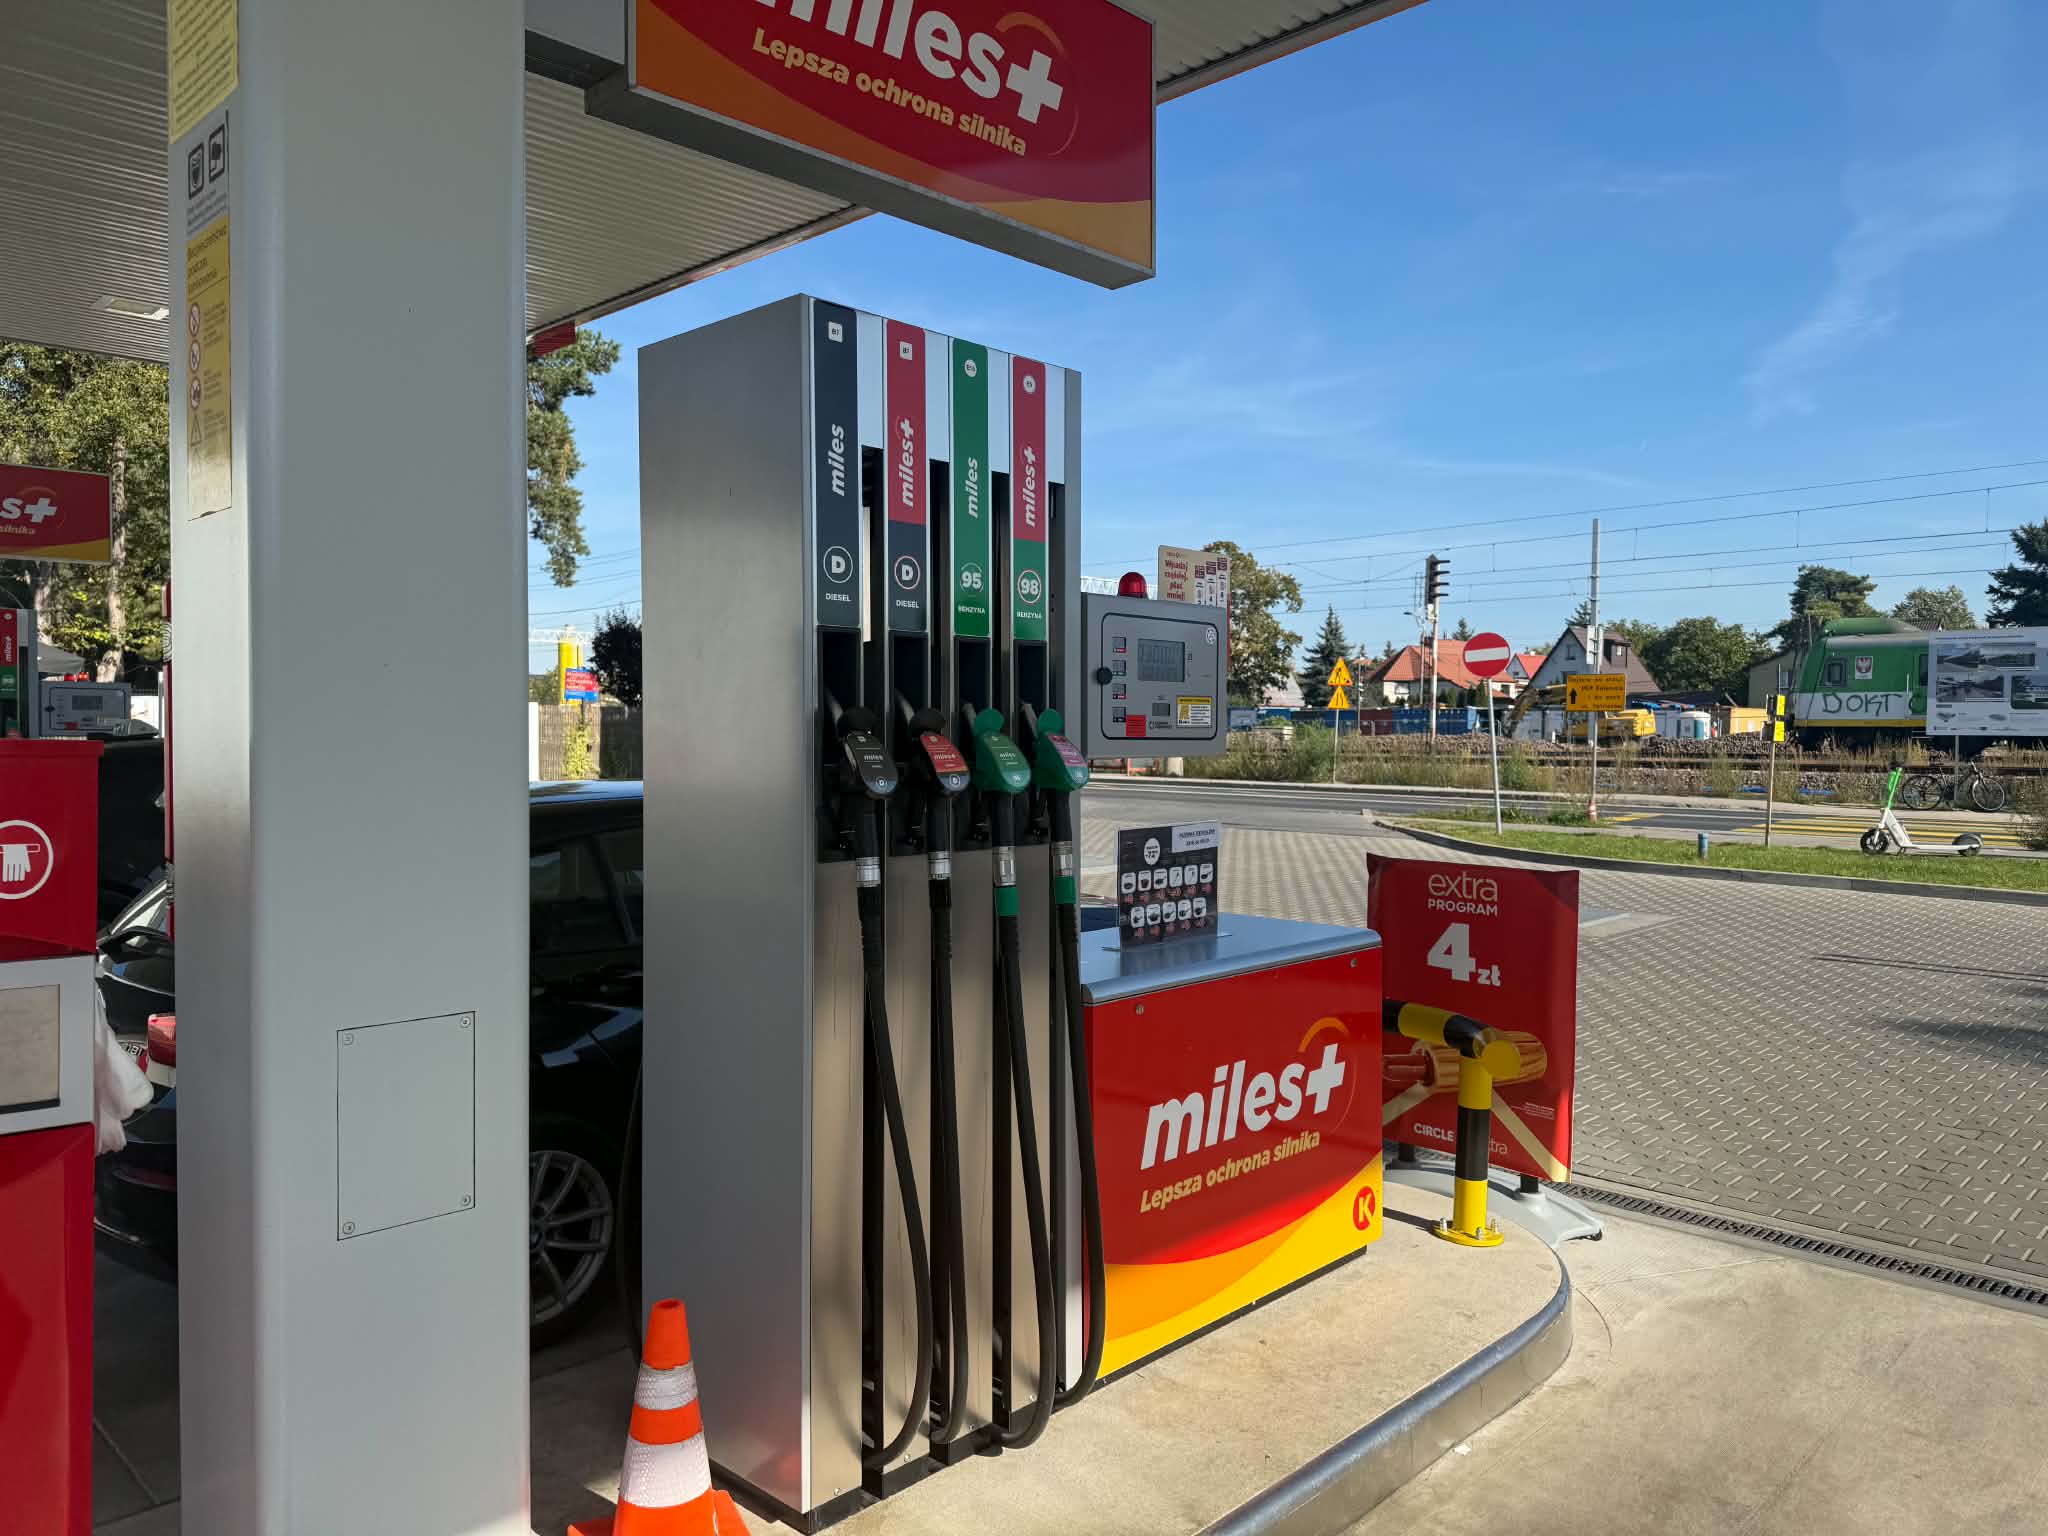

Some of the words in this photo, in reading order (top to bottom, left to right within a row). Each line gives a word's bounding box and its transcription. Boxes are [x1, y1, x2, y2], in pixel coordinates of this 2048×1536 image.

[752, 27, 850, 85] Lepsza
[855, 72, 954, 126] ochrona
[958, 112, 1027, 156] silnika
[828, 424, 844, 496] miles
[899, 418, 914, 508] miles+
[965, 457, 978, 519] miles
[1022, 446, 1036, 528] miles+
[831, 555, 846, 574] D
[901, 564, 914, 581] D
[961, 572, 983, 590] 95
[1020, 578, 1038, 595] 98
[825, 592, 852, 602] DIESEL
[895, 599, 920, 609] DIESEL
[1428, 871, 1498, 902] extra
[1427, 899, 1498, 916] PROGRAM
[1140, 1043, 1345, 1171] miles+
[1413, 1123, 1455, 1142] CIRCLE
[1139, 1175, 1202, 1213] Lepsza
[1206, 1149, 1271, 1188] ochrona
[1273, 1129, 1321, 1162] silnika
[1357, 1191, 1373, 1223] K
